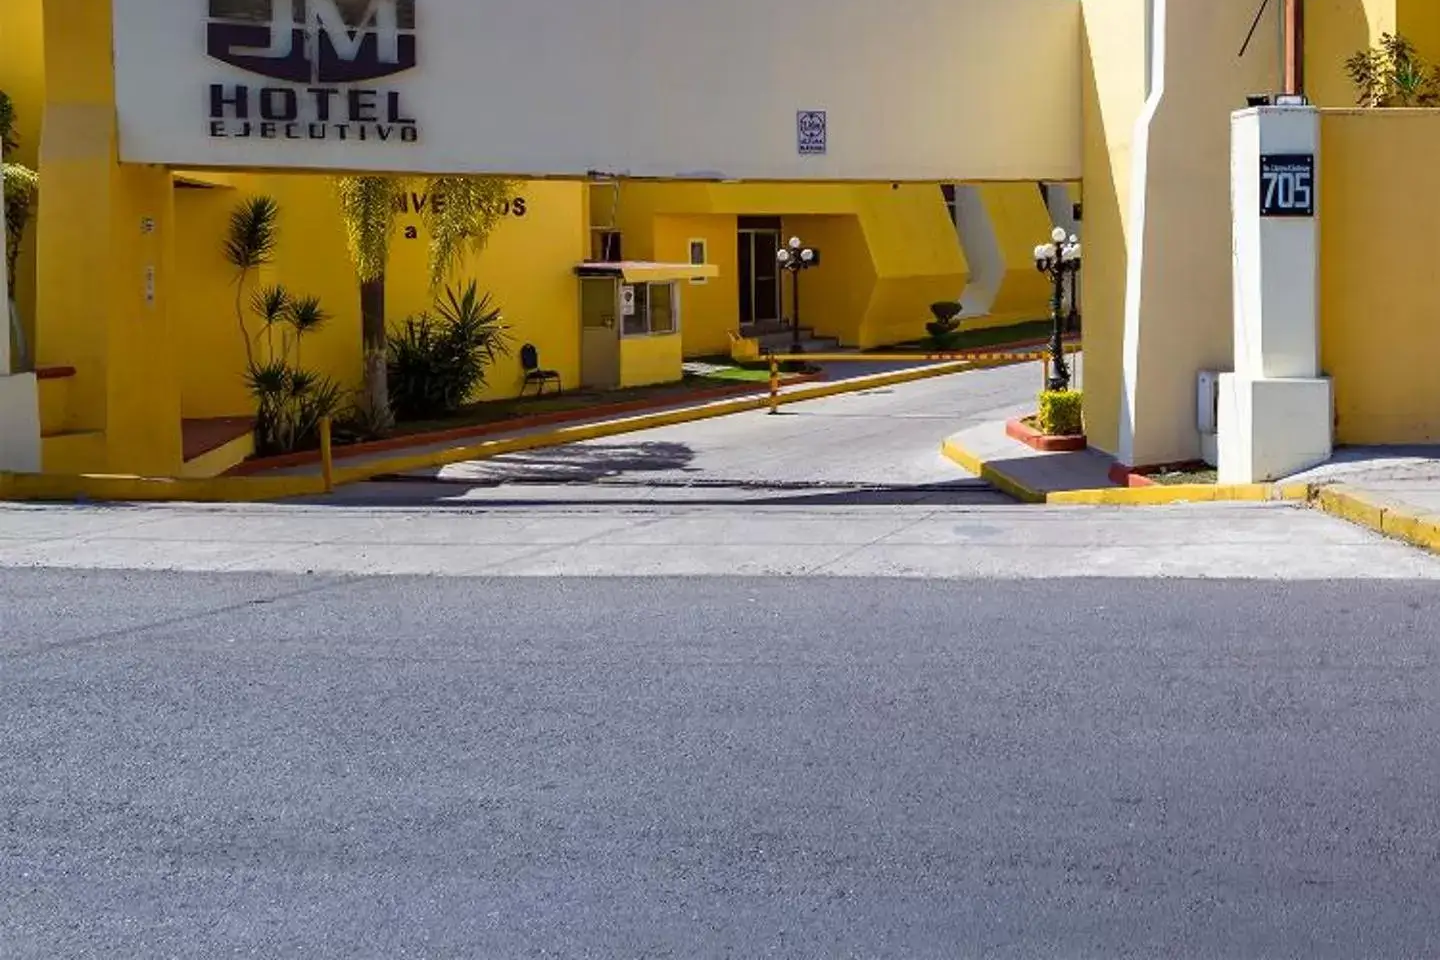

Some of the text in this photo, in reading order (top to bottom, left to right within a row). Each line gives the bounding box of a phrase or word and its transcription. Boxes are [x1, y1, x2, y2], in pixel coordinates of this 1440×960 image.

[209, 84, 416, 123] HOTEL
[210, 121, 418, 141] EJECUTIVO
[1262, 172, 1310, 208] 705
